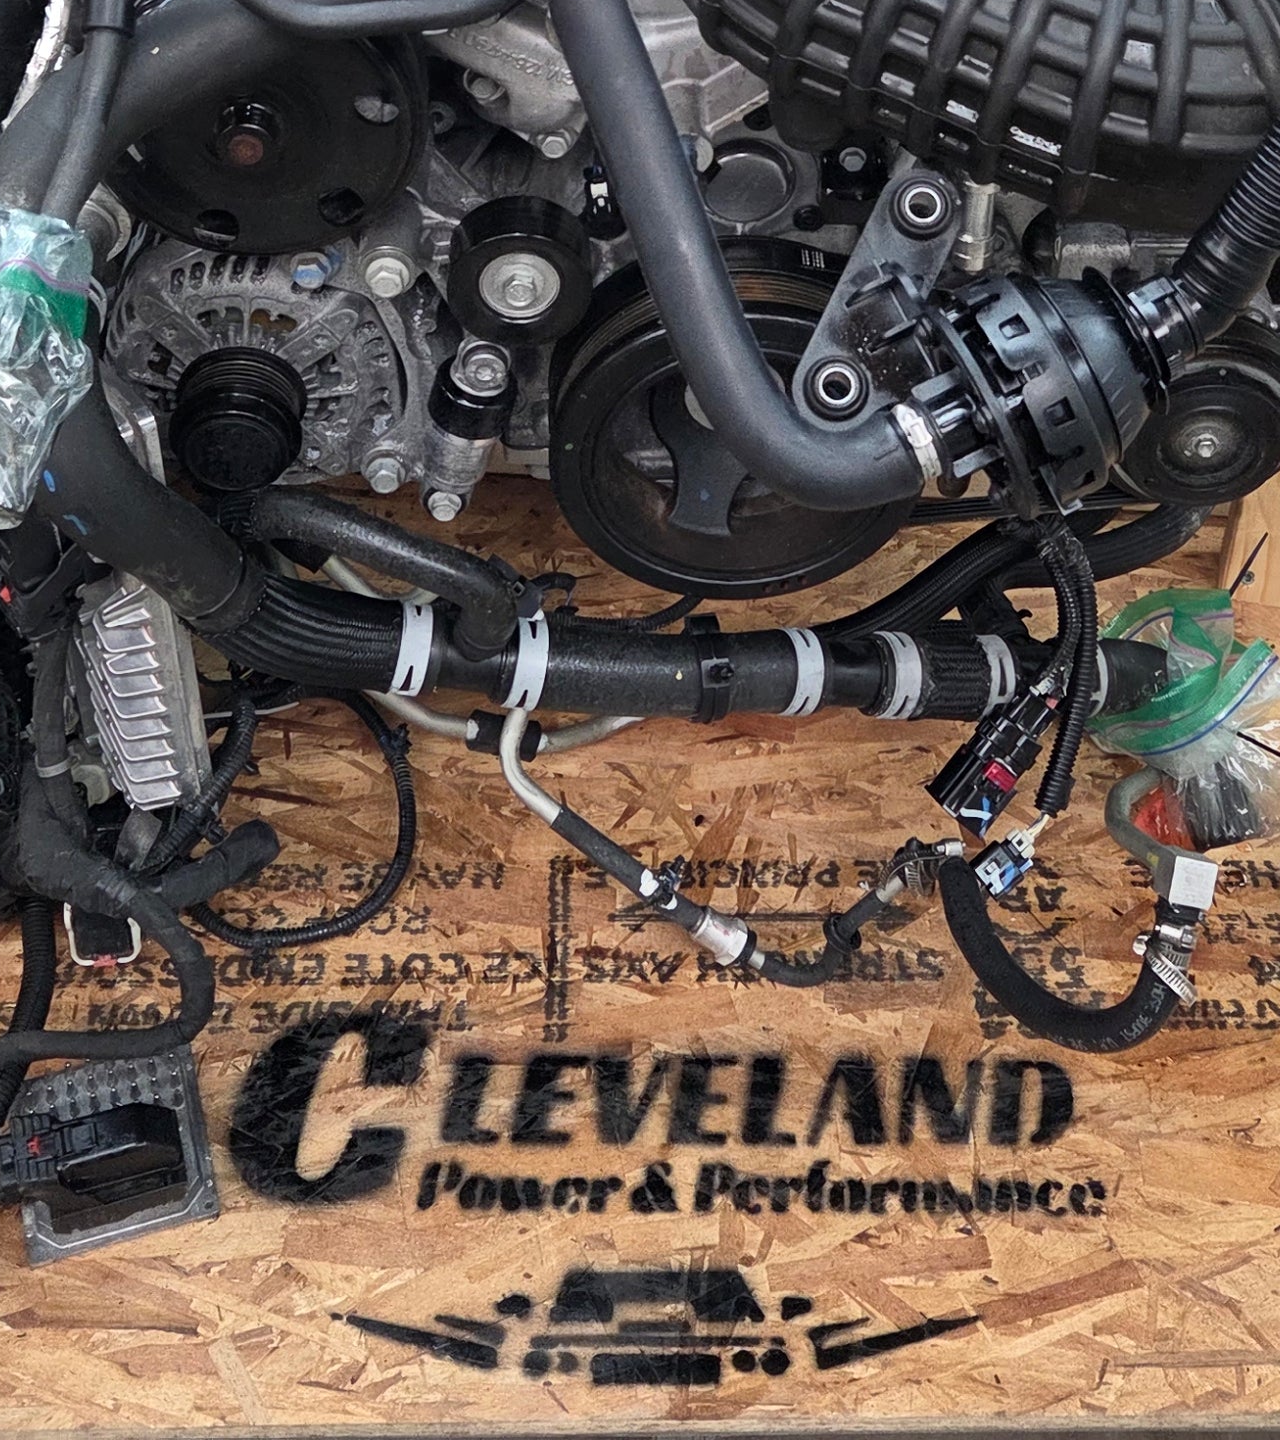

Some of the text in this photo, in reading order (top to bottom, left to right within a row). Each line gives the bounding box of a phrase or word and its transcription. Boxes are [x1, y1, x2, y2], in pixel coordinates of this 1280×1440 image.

[228, 1008, 1076, 1206] CLEVELAND
[414, 1157, 1108, 1217] Power & Performance
